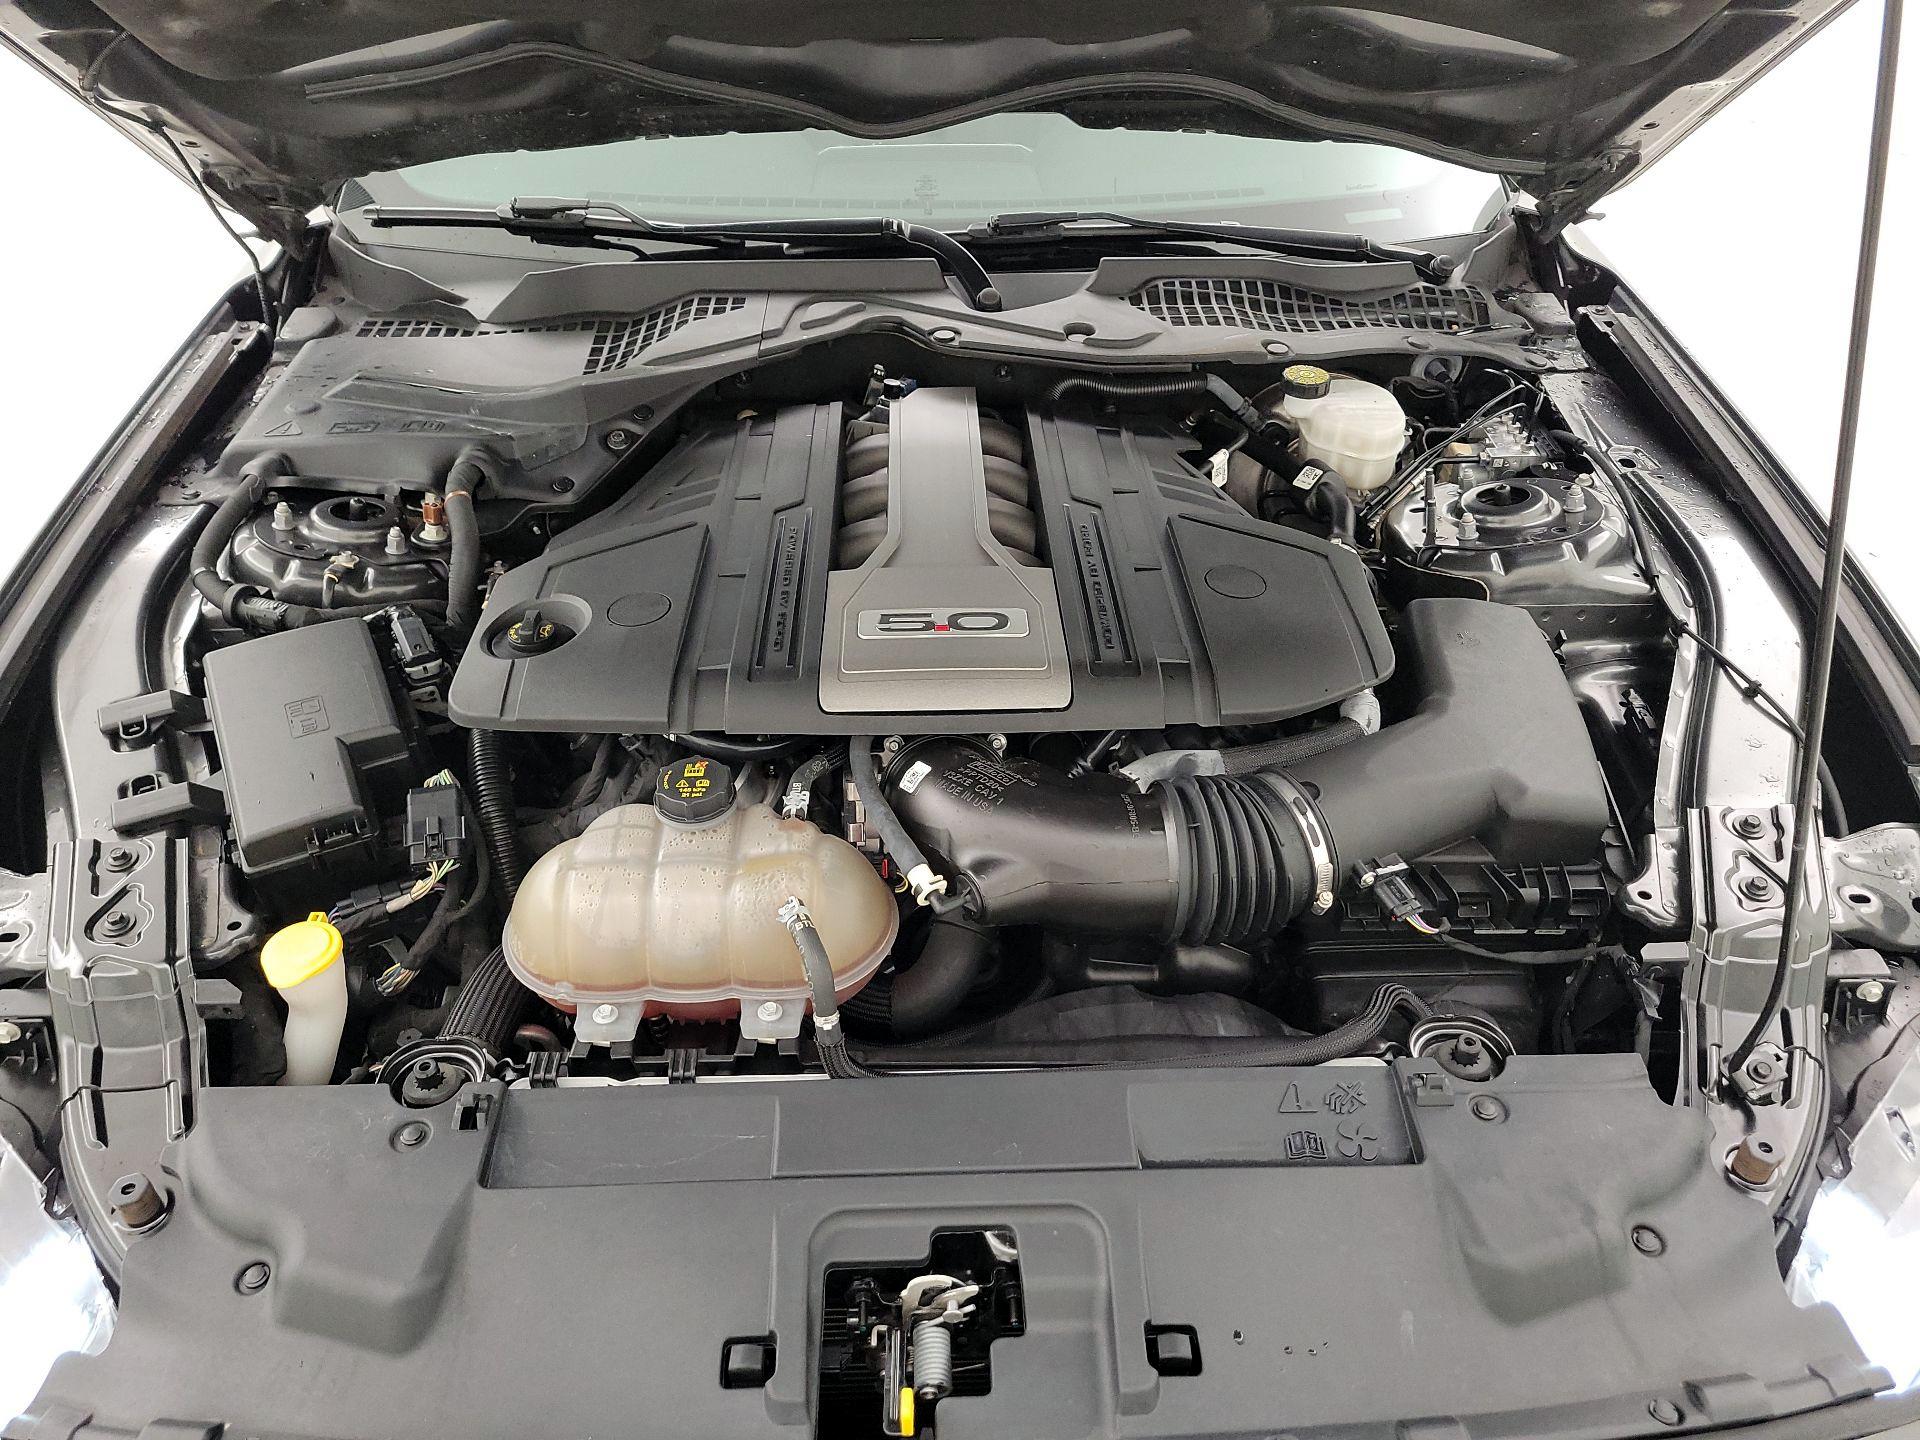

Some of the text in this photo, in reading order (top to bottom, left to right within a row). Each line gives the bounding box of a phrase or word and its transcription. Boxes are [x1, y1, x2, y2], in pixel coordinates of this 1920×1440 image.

[782, 527, 799, 587] POWERED
[779, 590, 791, 609] BY
[875, 612, 1010, 632] 5.0
[936, 779, 994, 816] MADE IN USA
